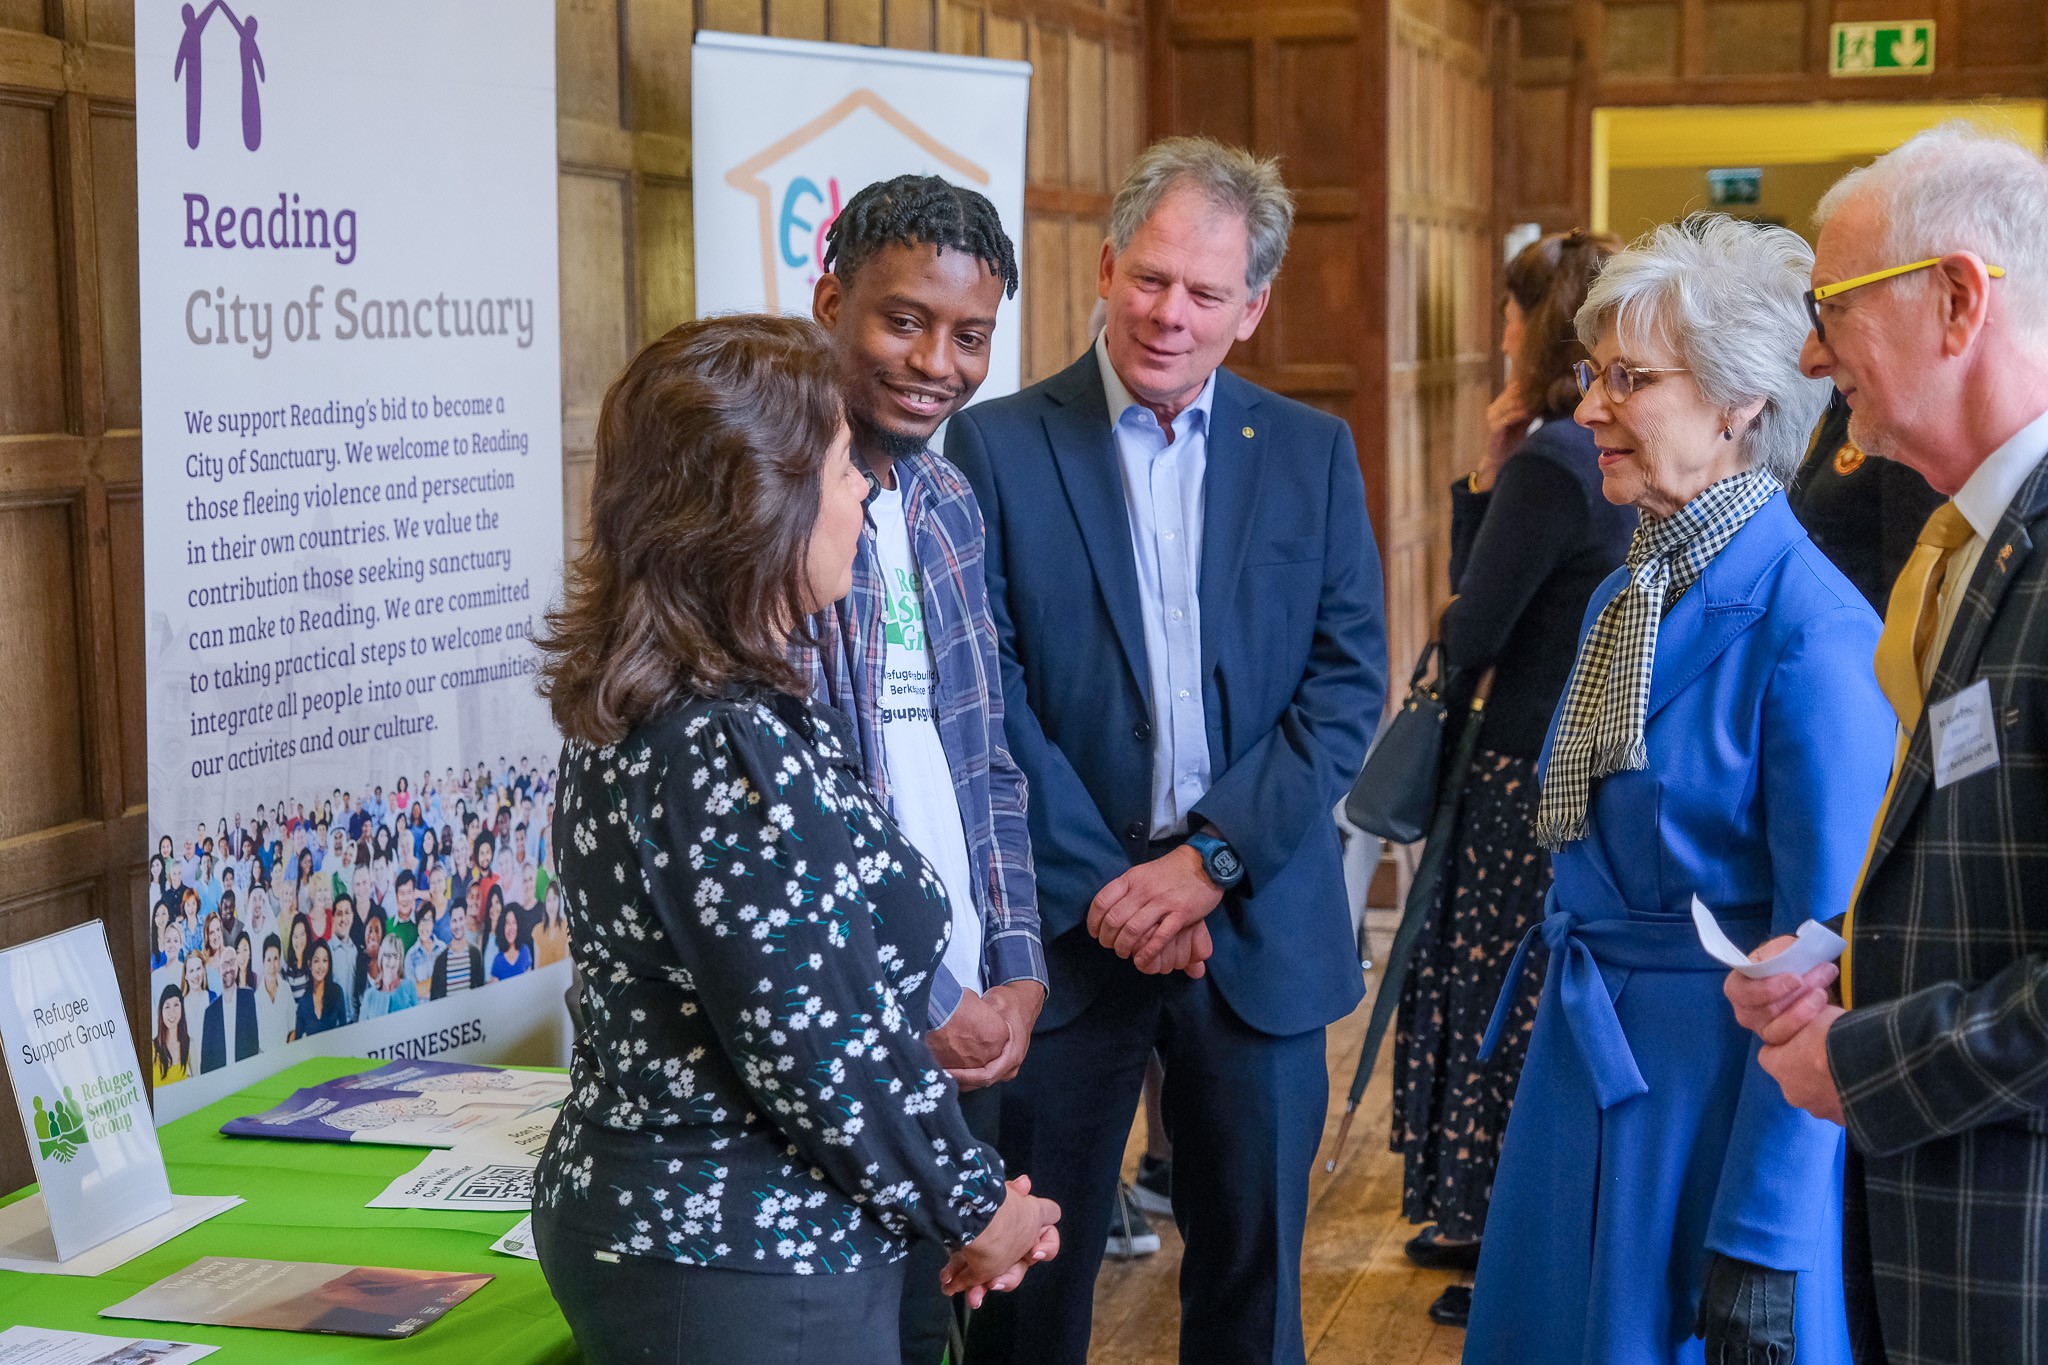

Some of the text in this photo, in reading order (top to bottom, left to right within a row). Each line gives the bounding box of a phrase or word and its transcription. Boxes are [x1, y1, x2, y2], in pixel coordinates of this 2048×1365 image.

[183, 192, 357, 265] Reading
[185, 285, 534, 360] City of Sanctuary
[184, 395, 504, 437] We support Reading's bid to become a
[186, 429, 528, 483] City of Sanctuary. We welcome to Reading
[186, 469, 514, 522] those fleeing violence and persecution
[187, 508, 498, 565] in their own countries. We value the
[188, 549, 510, 607] contribution those seeking sanctuary
[189, 578, 529, 650] can make to Reading. We are committed
[190, 615, 533, 693] to taking practical steps to welcome and
[191, 654, 537, 736] integrate all people into our communities
[192, 715, 437, 778] our activites and our culture.
[33, 998, 89, 1028] Refugee
[22, 1019, 116, 1064] Support Group
[81, 1070, 134, 1101] Refugee
[86, 1086, 139, 1122] Support
[92, 1112, 132, 1140] Group
[405, 1180, 429, 1195] Scan
[423, 1186, 442, 1197] Our
